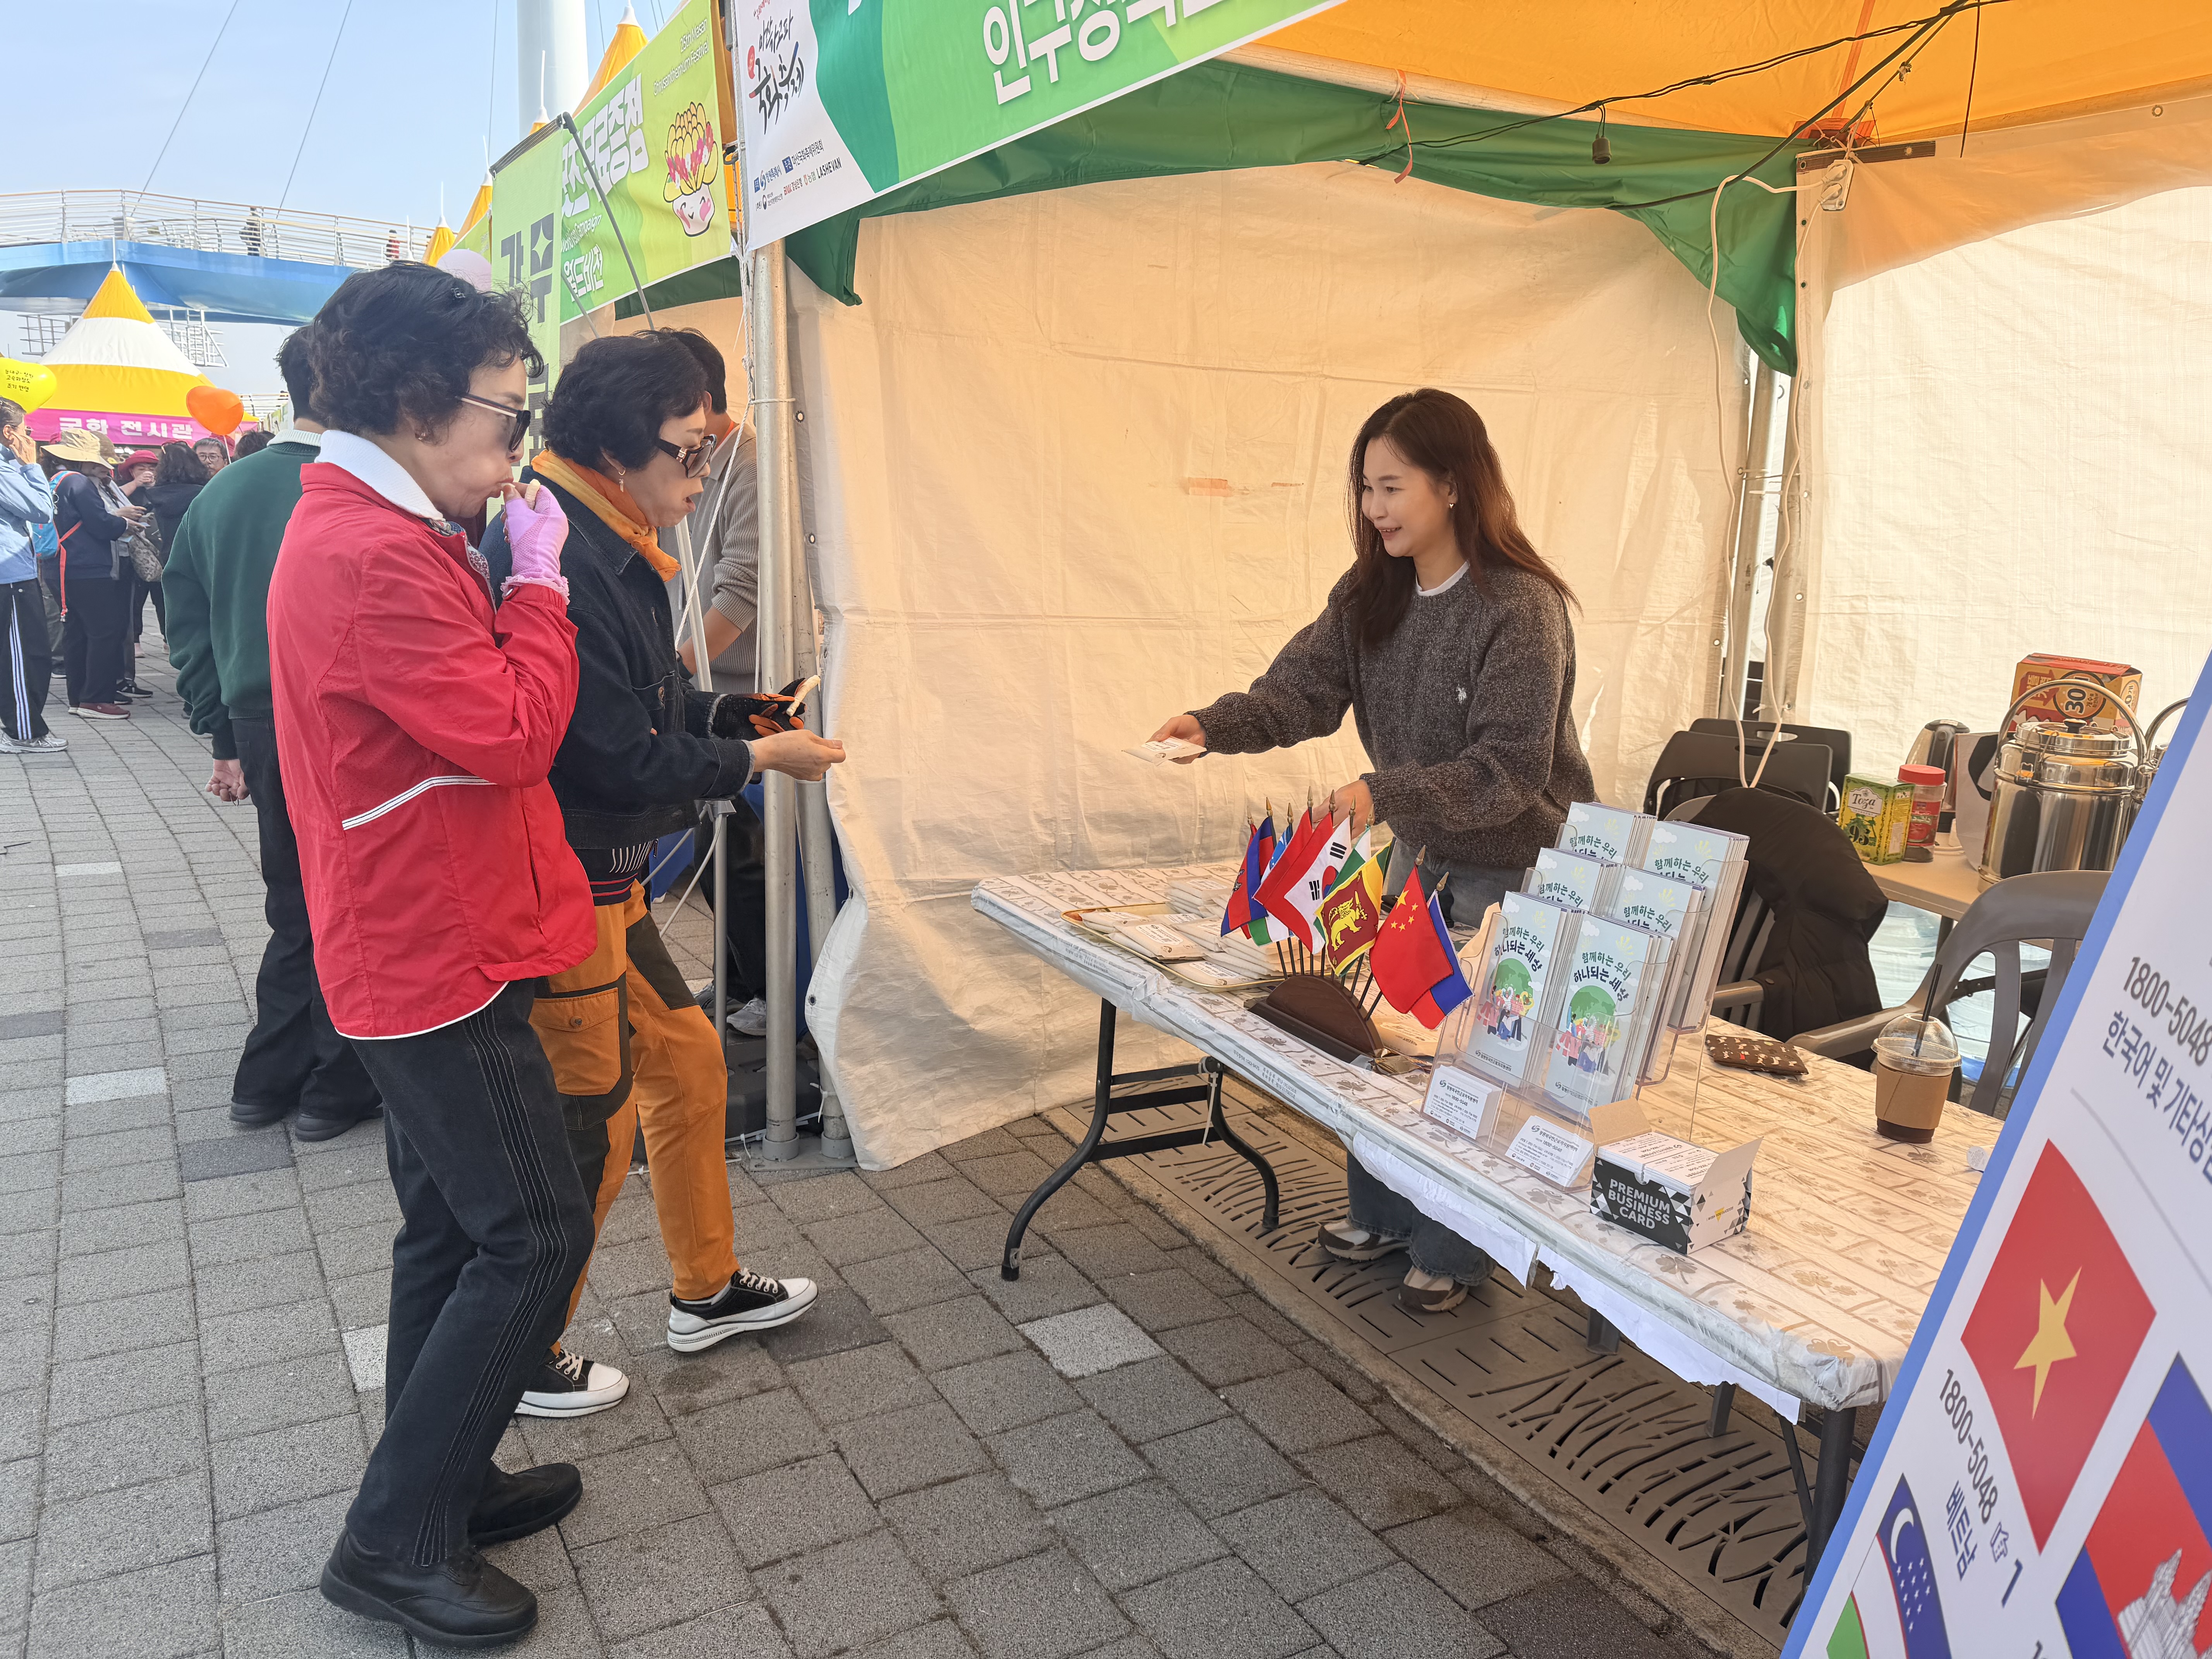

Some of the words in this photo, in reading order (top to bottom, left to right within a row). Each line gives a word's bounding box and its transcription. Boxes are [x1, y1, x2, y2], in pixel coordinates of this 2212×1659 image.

[680, 31, 691, 53] 25th
[692, 19, 708, 40] Masan
[653, 58, 690, 96] Chrysanthemum
[690, 36, 709, 65] Festival
[807, 170, 816, 183] 농협
[816, 156, 842, 179] LASHEVAN
[564, 244, 604, 302] 월드비전
[120, 419, 194, 440] 전시관
[1852, 793, 1877, 809] Toza
[1569, 835, 1601, 848] 함께하는
[1601, 842, 1618, 859] 우리
[1654, 857, 1692, 872] 함께하는
[1691, 866, 1709, 884] 우리
[1538, 882, 1568, 896] 함께하는
[1568, 890, 1583, 908] 우리
[1623, 905, 1656, 920] 함께하는
[1655, 914, 1672, 933] 우리
[1494, 939, 1525, 957] 하나되는
[1524, 950, 1543, 972] 세상
[1503, 926, 1530, 940] 함께하는
[1530, 935, 1545, 953] 우리
[1582, 951, 1614, 967] 함께하는
[1614, 962, 1632, 981] 우리
[1573, 966, 1609, 983] 하나되는
[1609, 977, 1629, 1002] 세상
[2123, 956, 2212, 1067] 1800-5048
[2102, 1010, 2157, 1089] 한국어
[2146, 1056, 2174, 1109] 및
[2163, 1077, 2212, 1186] 기타상
[1608, 1189, 1670, 1225] BUSINESS
[1609, 1178, 1670, 1214] PREMIUM
[1619, 1206, 1656, 1230] CARD
[1939, 1369, 1999, 1525] 1800-5048
[2001, 1558, 2023, 1608] 1
[1945, 1479, 1978, 1582] 베트남
